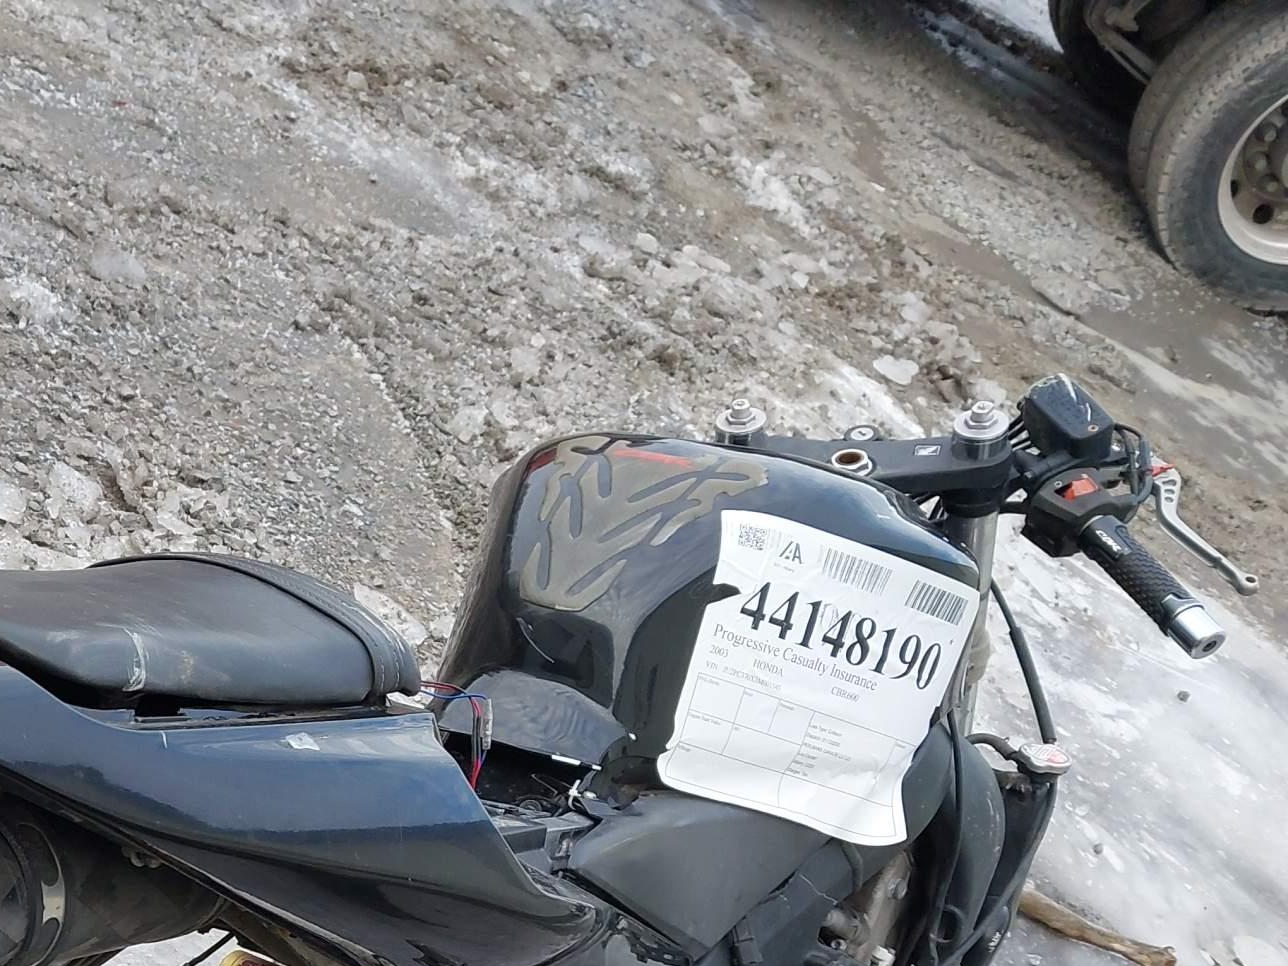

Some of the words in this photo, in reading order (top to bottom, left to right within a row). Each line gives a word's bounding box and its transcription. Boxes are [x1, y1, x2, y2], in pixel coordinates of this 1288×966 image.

[708, 644, 729, 658] 2003
[752, 658, 784, 677] HONDA
[713, 623, 780, 658] Progressive
[782, 647, 829, 676] Casualty
[829, 663, 878, 691] Insurance
[739, 581, 942, 690] 44148190
